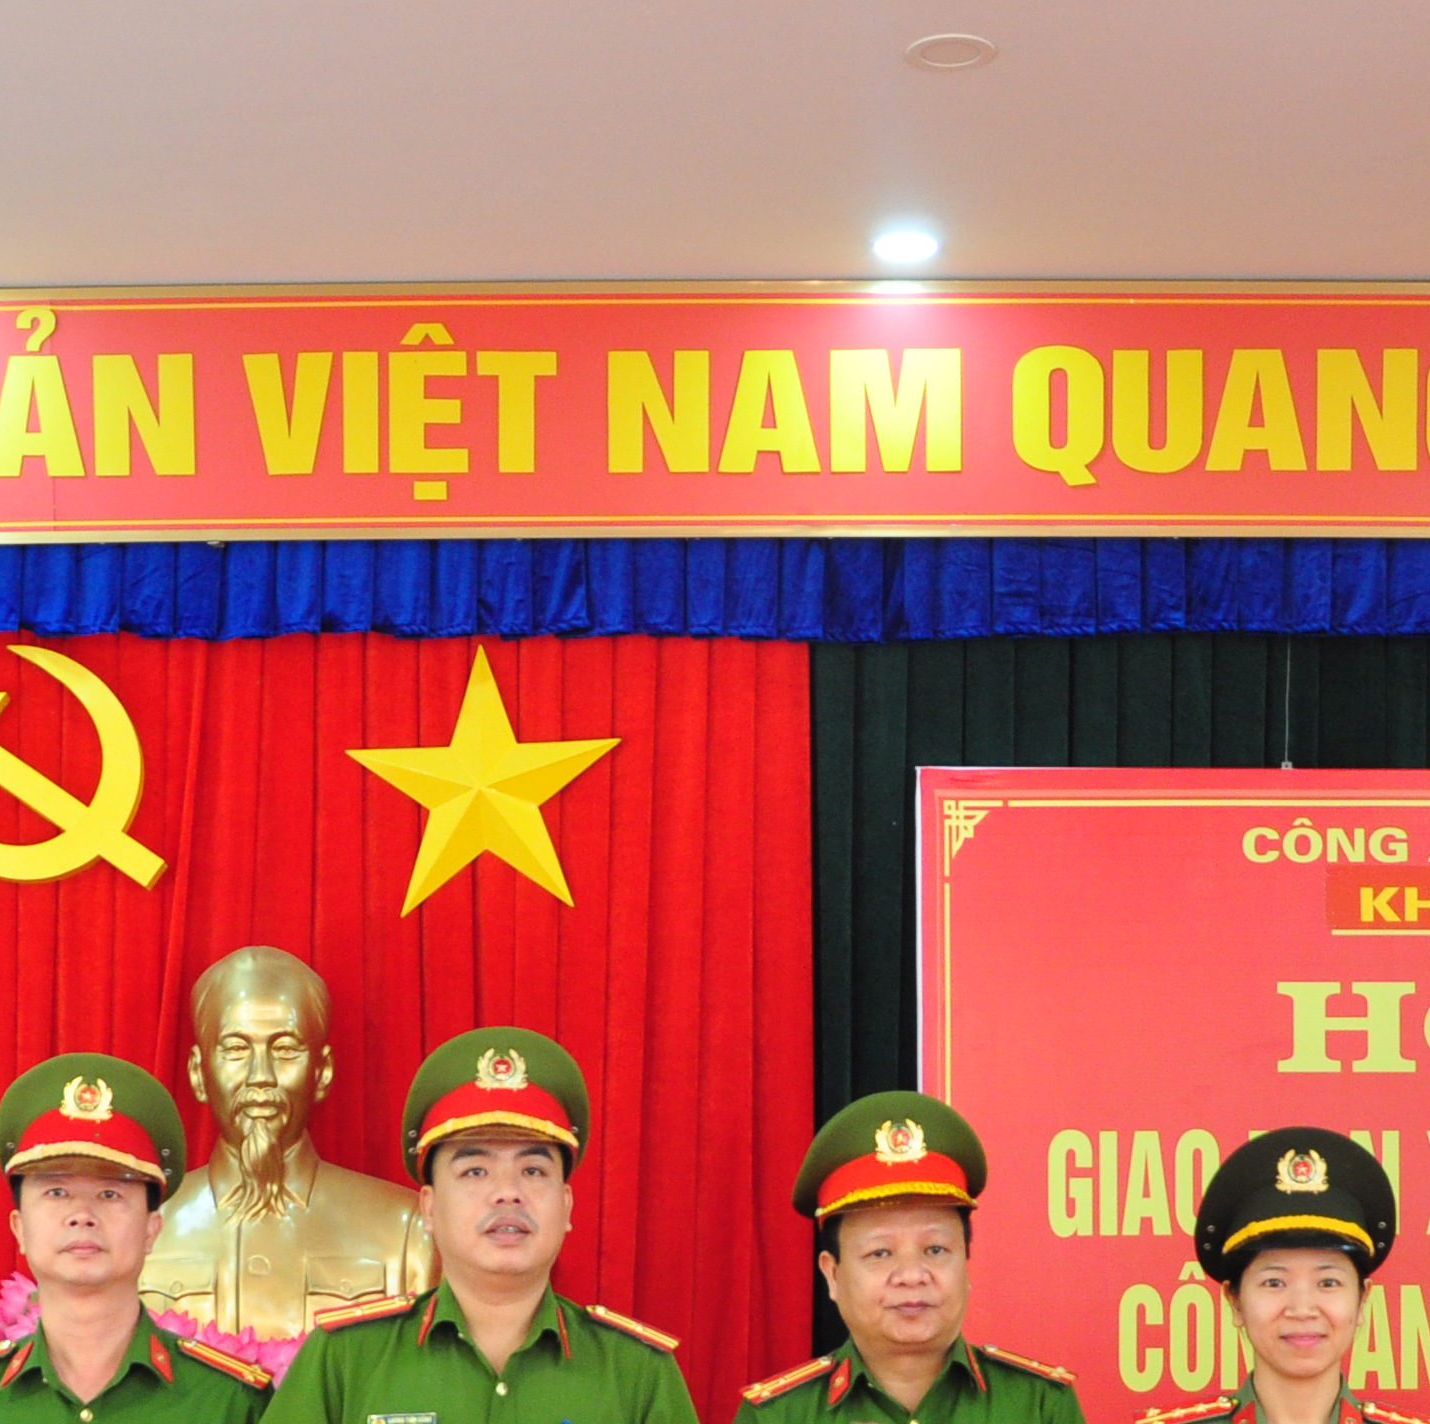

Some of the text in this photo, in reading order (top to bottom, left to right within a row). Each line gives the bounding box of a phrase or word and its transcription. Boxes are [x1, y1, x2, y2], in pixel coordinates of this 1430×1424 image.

[242, 324, 560, 501] VIỆT
[608, 348, 964, 475] NAM
[1242, 818, 1409, 863] CÔNG
[1047, 1128, 1221, 1239] GIAO
[1118, 1261, 1254, 1393] CÔN
